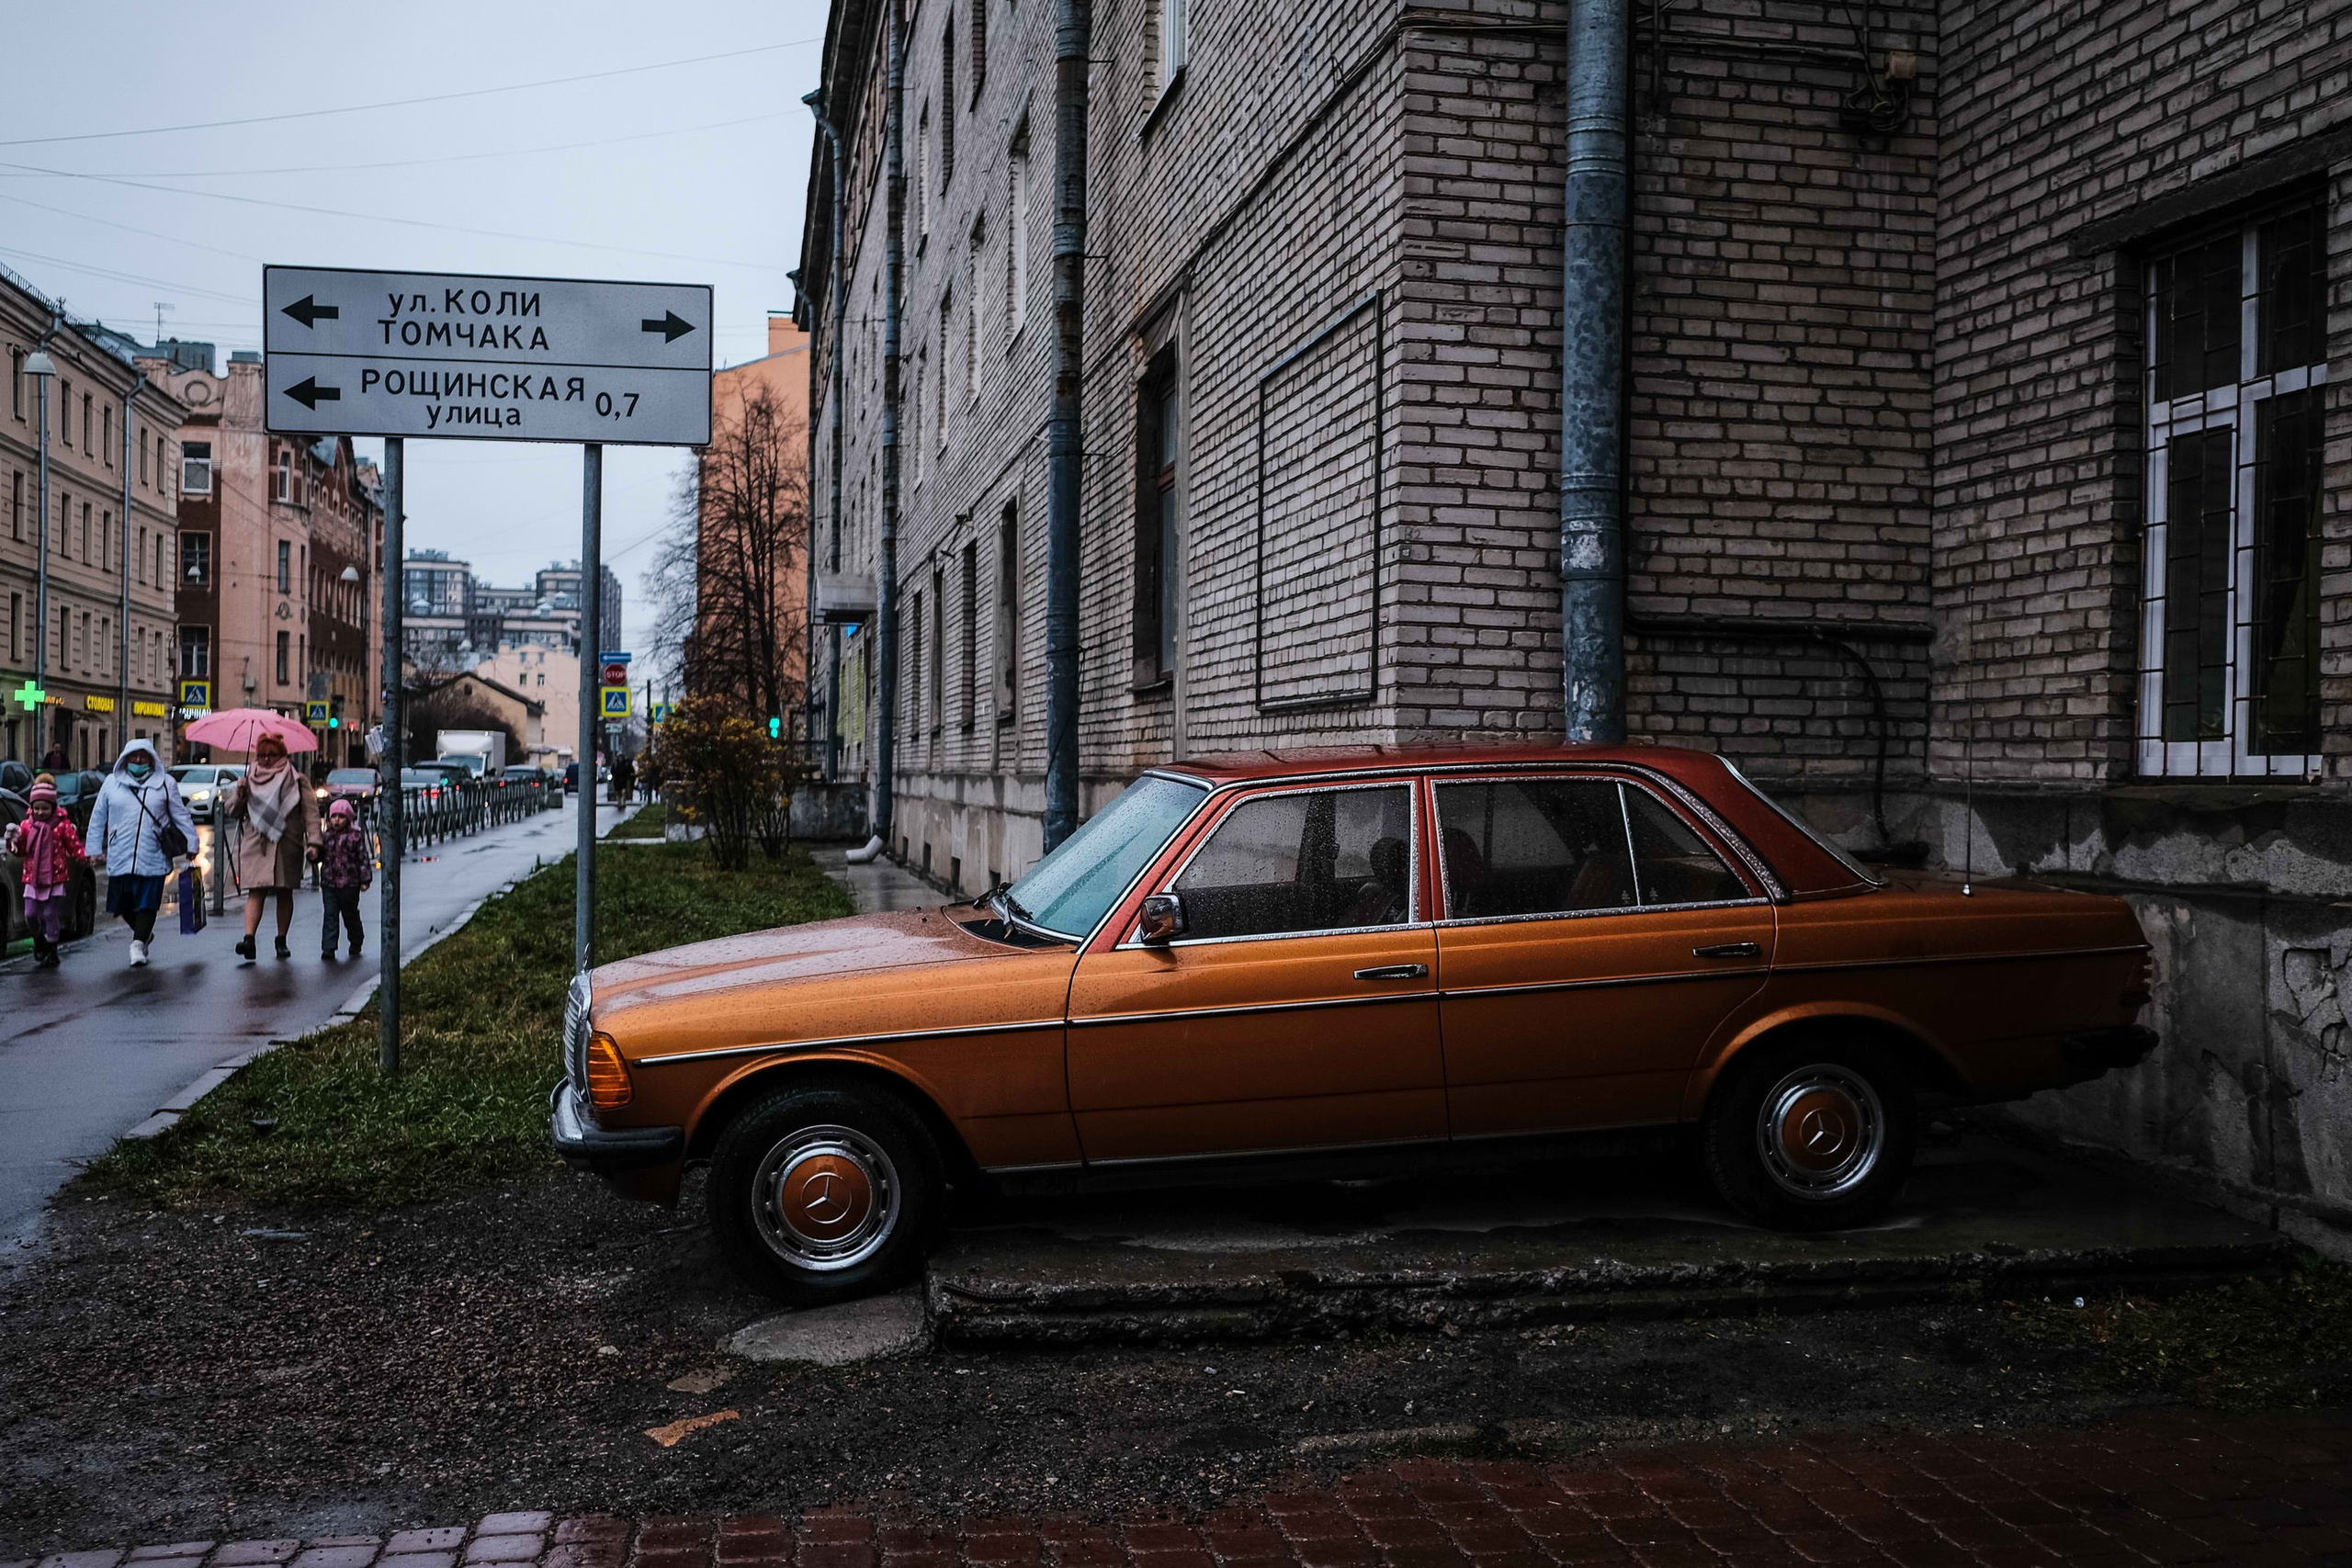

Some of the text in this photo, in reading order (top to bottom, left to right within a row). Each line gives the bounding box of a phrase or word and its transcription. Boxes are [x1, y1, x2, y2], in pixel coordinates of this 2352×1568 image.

[388, 288, 540, 318] ул. КОЛИ
[377, 319, 549, 351] ТОМЧАКА
[361, 368, 585, 401] РОЩИНСКАЯ
[426, 404, 522, 430] улица
[594, 391, 640, 422] 0,7
[605, 671, 626, 679] STOP
[86, 694, 114, 712] СТОЛОВАЯ
